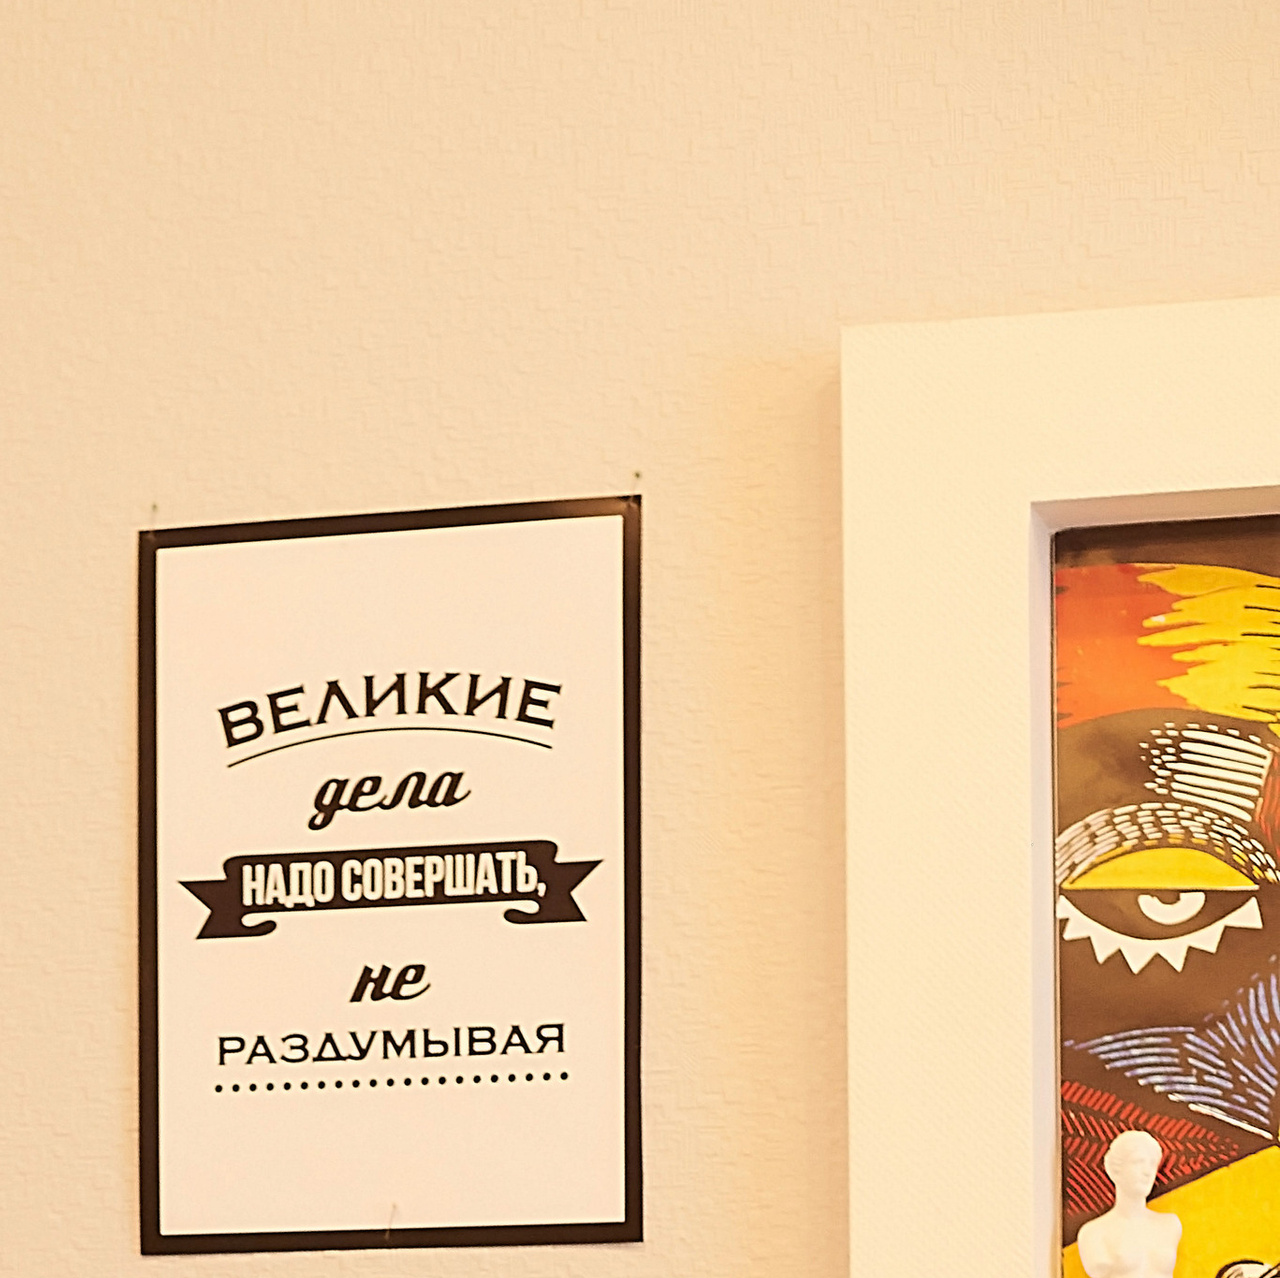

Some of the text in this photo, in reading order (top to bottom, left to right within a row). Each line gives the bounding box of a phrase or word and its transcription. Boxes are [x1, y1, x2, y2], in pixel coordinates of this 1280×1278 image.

[217, 672, 562, 748] ВЕЛИКИЕ
[307, 770, 472, 831] дела
[242, 850, 547, 908] НАДО СОВЕРШАТЬ,
[348, 963, 432, 1004] не
[217, 1022, 566, 1066] РАЗДУМЫВАЯ
